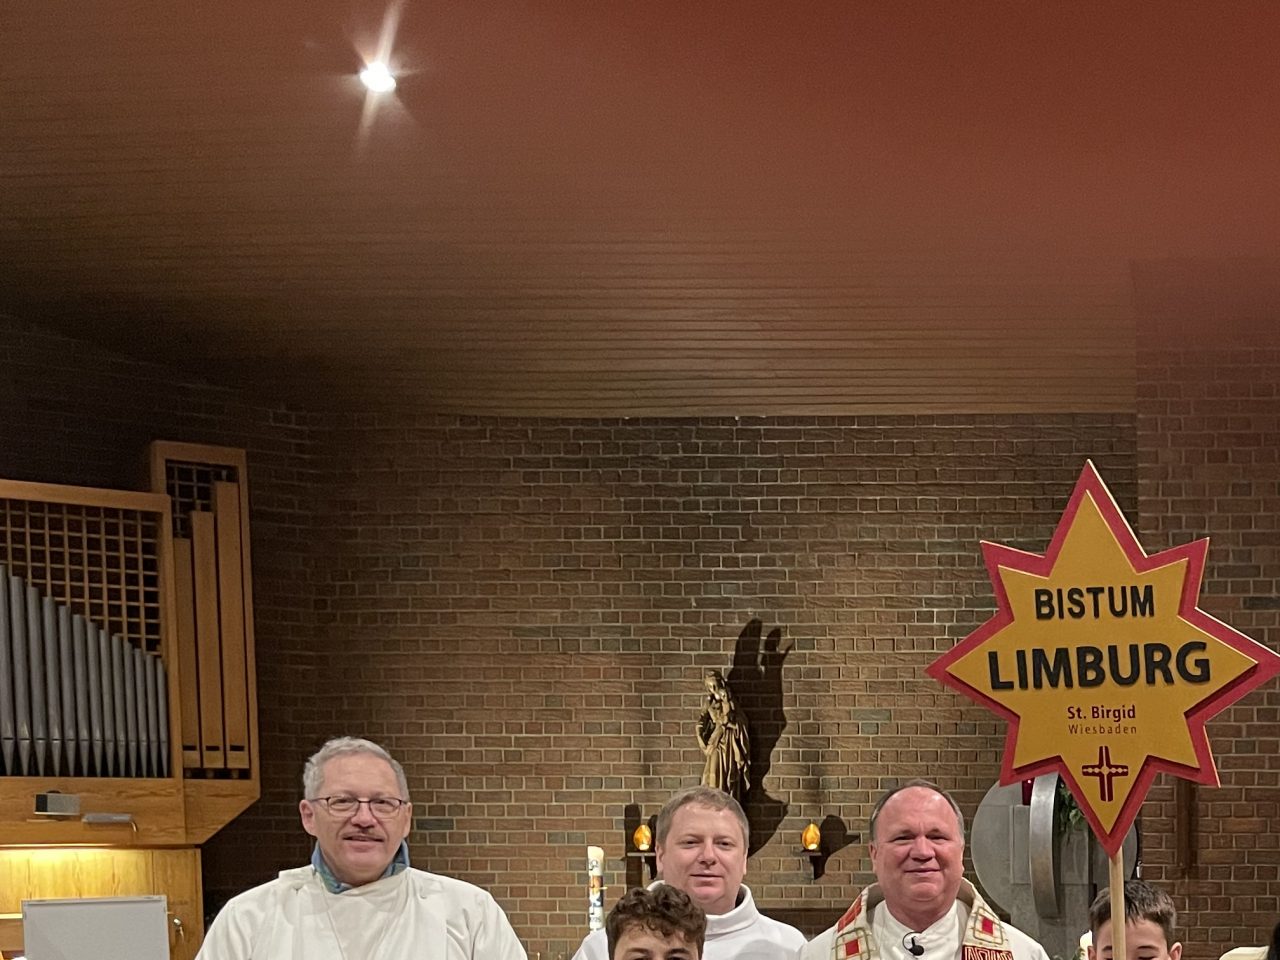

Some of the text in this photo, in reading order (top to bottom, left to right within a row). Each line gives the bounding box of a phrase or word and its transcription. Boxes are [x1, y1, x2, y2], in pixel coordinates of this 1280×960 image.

[1034, 584, 1155, 620] BISTUM
[988, 641, 1211, 690] LIMBURG
[1067, 704, 1136, 723] St. Birgid
[1068, 723, 1137, 735] Wiesbaden
